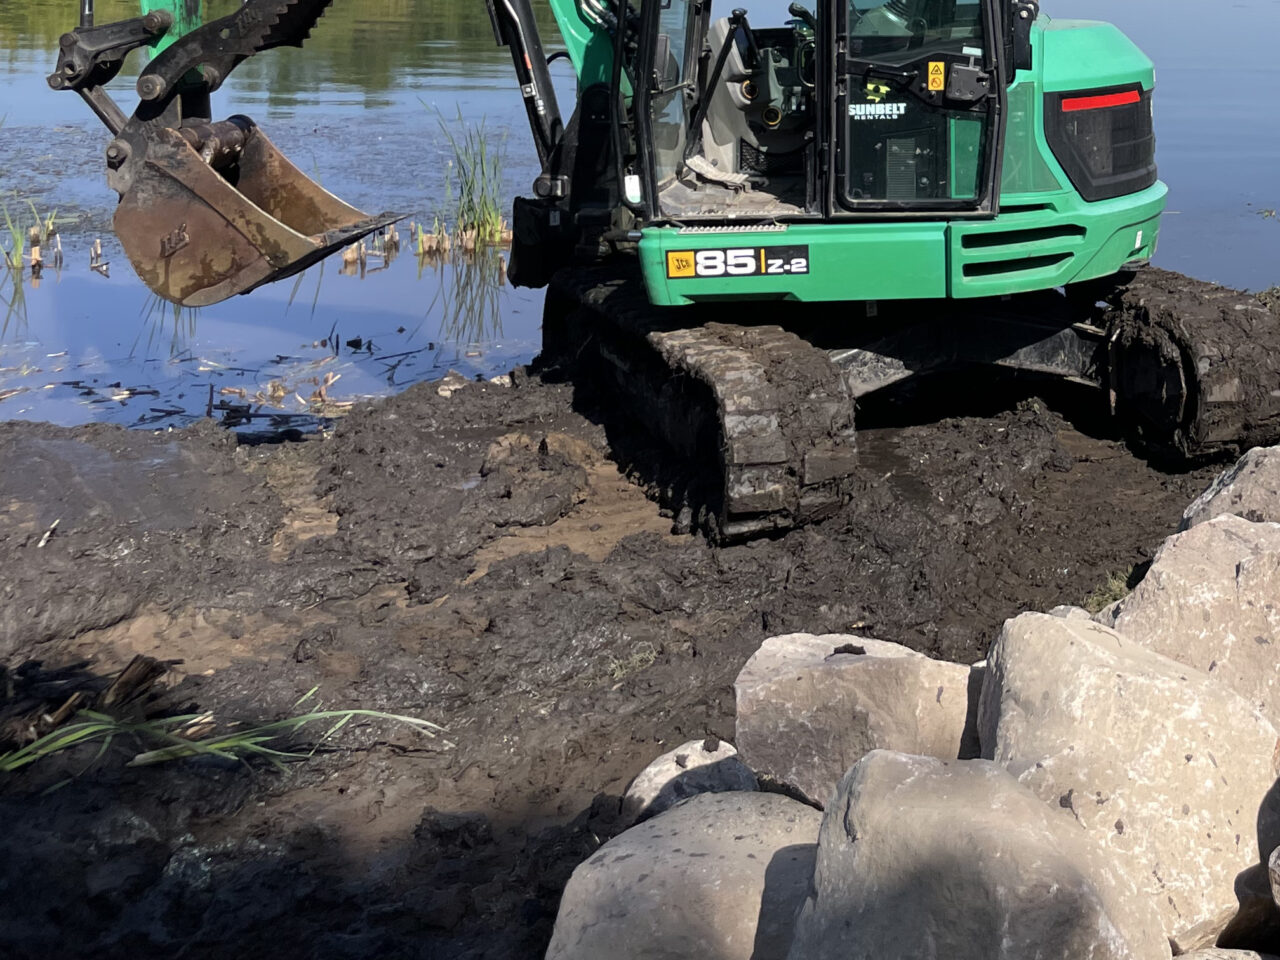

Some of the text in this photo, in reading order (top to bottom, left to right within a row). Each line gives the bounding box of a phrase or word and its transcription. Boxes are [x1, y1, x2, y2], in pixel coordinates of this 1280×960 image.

[848, 103, 907, 116] SUNBELT
[695, 248, 757, 276] 85
[767, 258, 808, 273] Z-2
